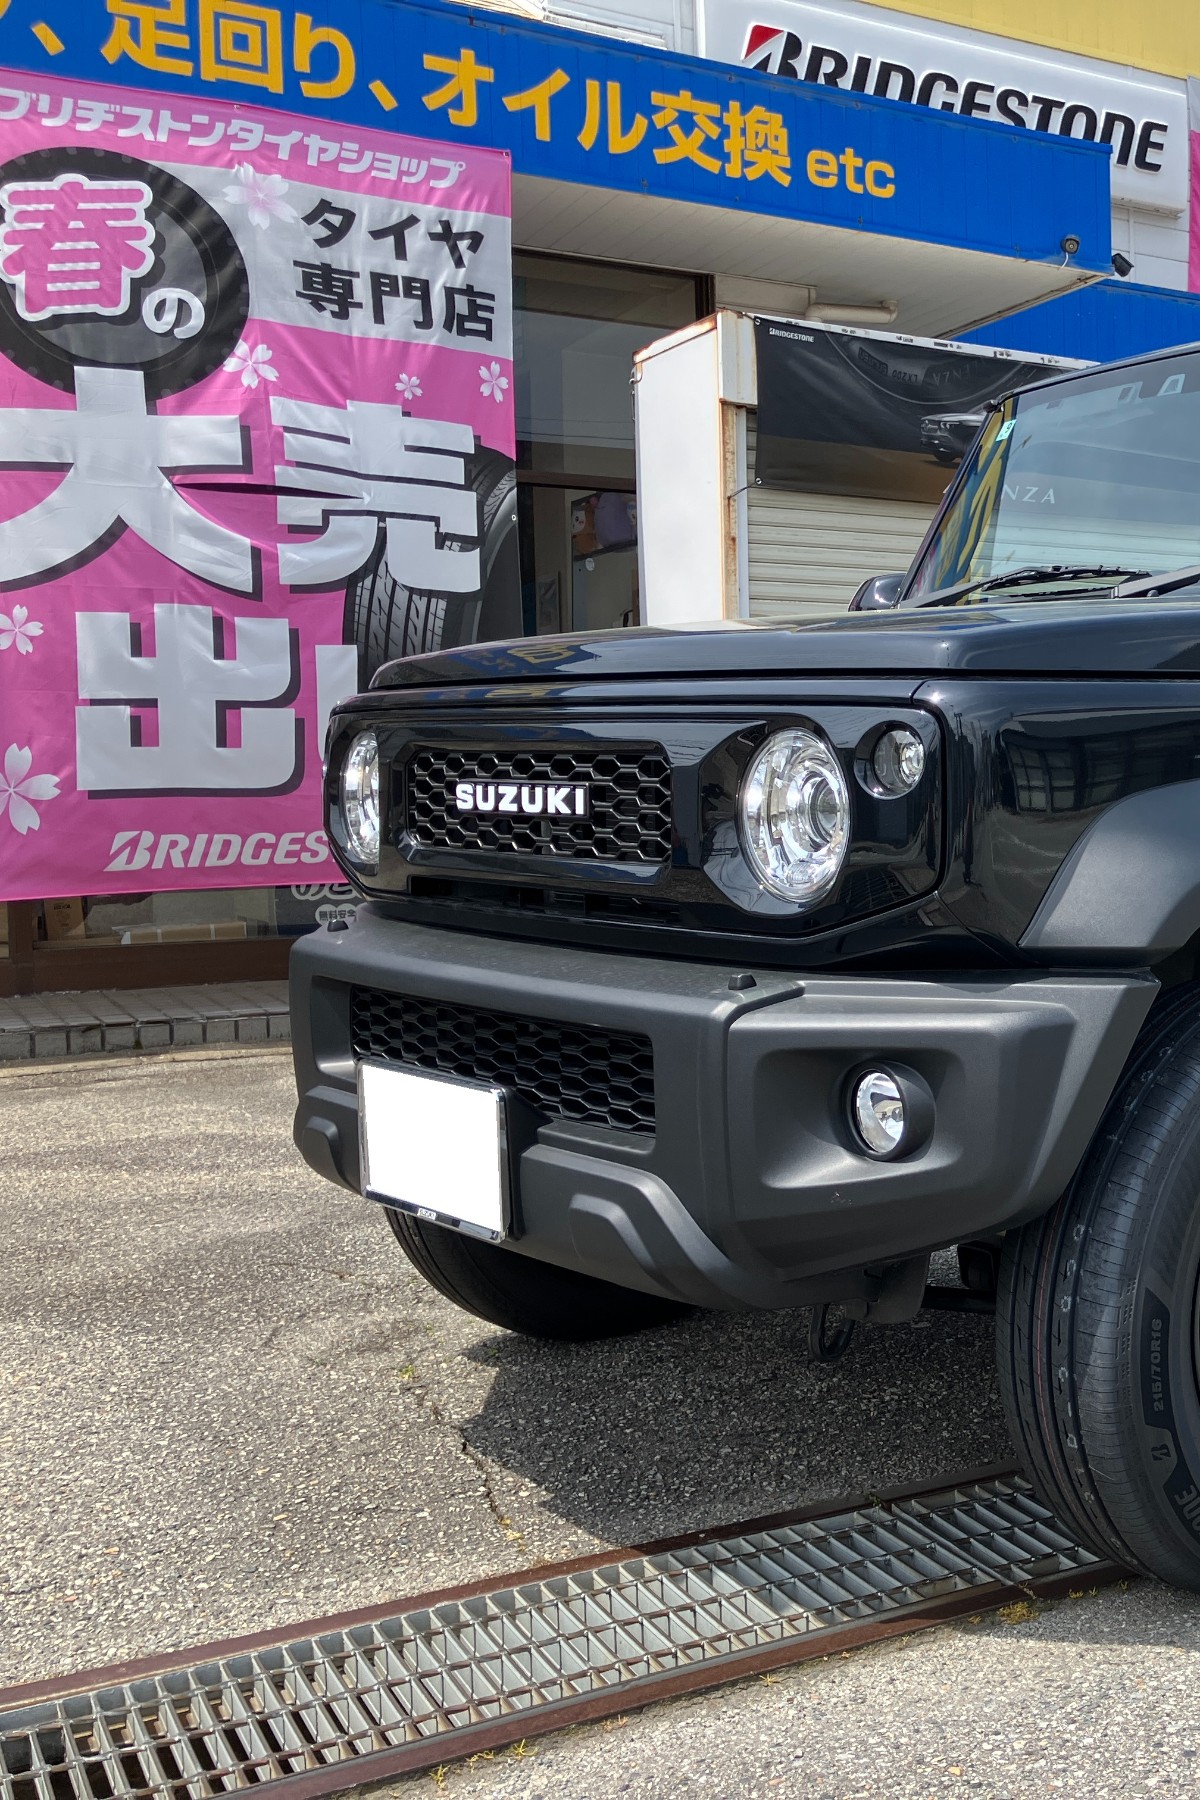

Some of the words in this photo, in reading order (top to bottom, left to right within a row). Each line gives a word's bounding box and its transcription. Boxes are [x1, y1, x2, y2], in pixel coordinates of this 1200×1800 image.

[0, 0, 791, 187] 、足回り、オイル交換
[807, 148, 896, 198] etc
[2, 173, 206, 339] 春の
[300, 197, 485, 269] タイヤ
[292, 261, 496, 342] 専門店
[768, 326, 815, 343] BRIDGESTONE
[455, 783, 585, 815] SUZUKI
[103, 830, 334, 872] BRIDGES
[1151, 1318, 1164, 1413] 215/70R16
